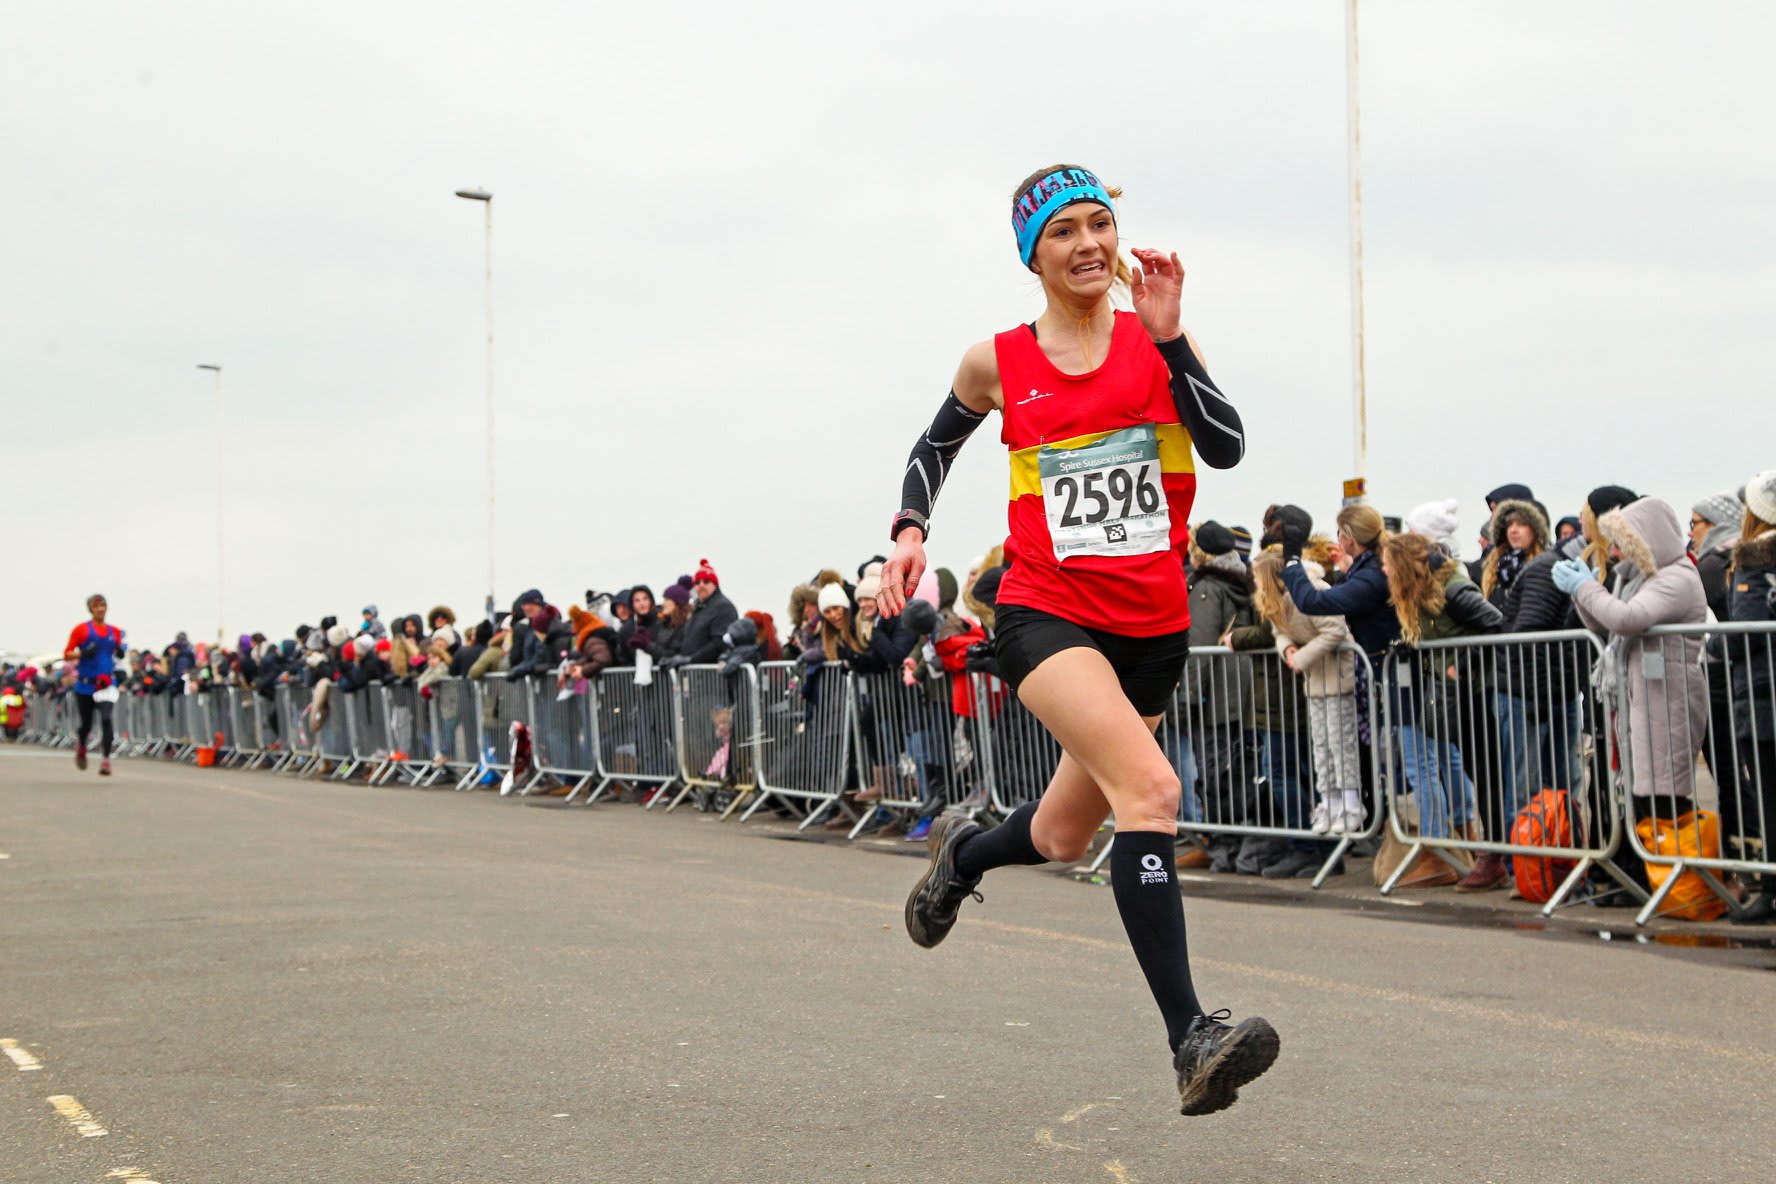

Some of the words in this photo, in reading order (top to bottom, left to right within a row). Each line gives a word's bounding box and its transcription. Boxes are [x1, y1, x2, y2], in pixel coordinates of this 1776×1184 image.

[1059, 462, 1082, 473] Spire
[1082, 456, 1111, 468] Sussex
[1112, 450, 1144, 462] Hospital
[1054, 464, 1160, 528] 2596
[1139, 871, 1168, 879] ZERO
[1141, 877, 1168, 885] POINT
